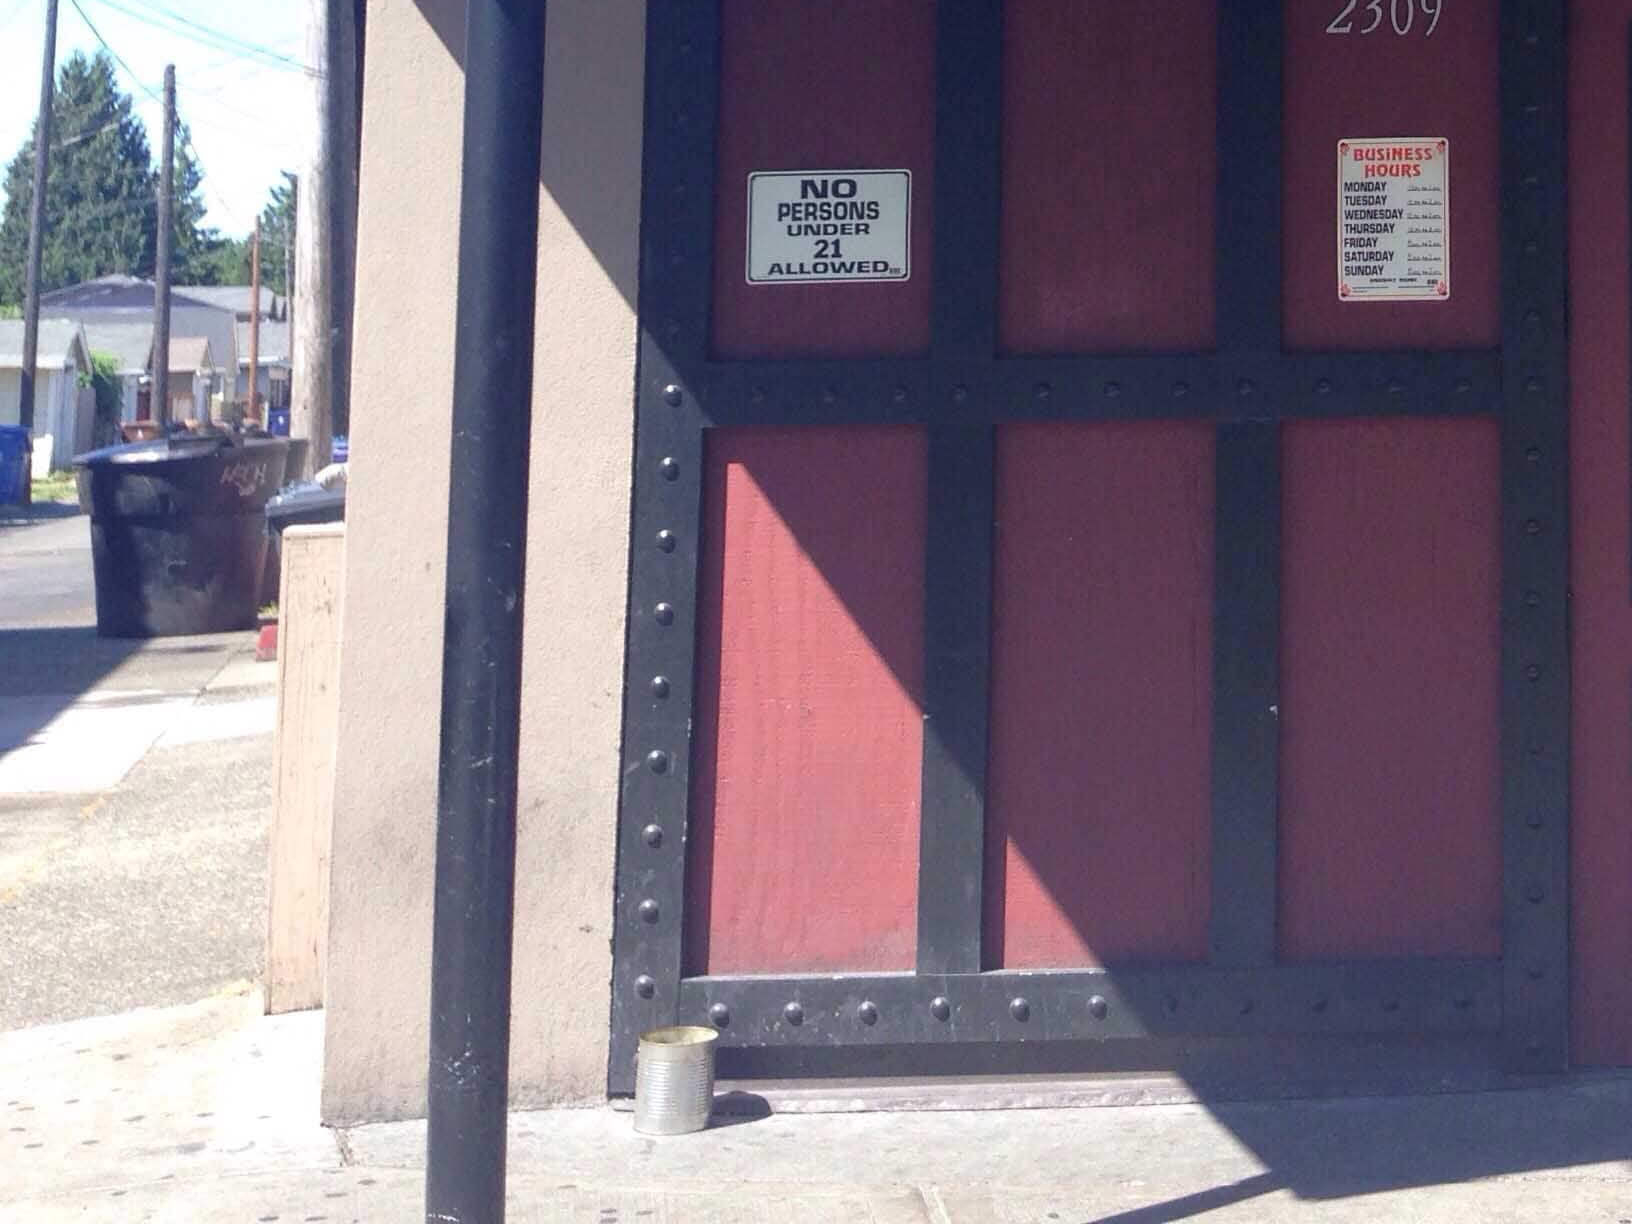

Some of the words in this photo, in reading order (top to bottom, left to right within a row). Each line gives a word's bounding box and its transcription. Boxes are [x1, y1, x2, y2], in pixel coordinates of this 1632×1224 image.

[1364, 164, 1422, 178] HOURS
[800, 178, 858, 200] NO
[1344, 181, 1387, 192] MONDAY
[1344, 195, 1387, 206] TUESDAY
[777, 201, 880, 222] PERSONS
[1344, 209, 1403, 220] WEDNESDAY
[786, 223, 870, 236] UNDER
[1344, 223, 1395, 234] THURSDAY
[1344, 237, 1378, 248] FRIDAY
[813, 238, 843, 259] 21
[1344, 251, 1395, 262] SATURDAY
[768, 261, 889, 275] ALLOWED
[1344, 265, 1384, 276] SUNDAY
